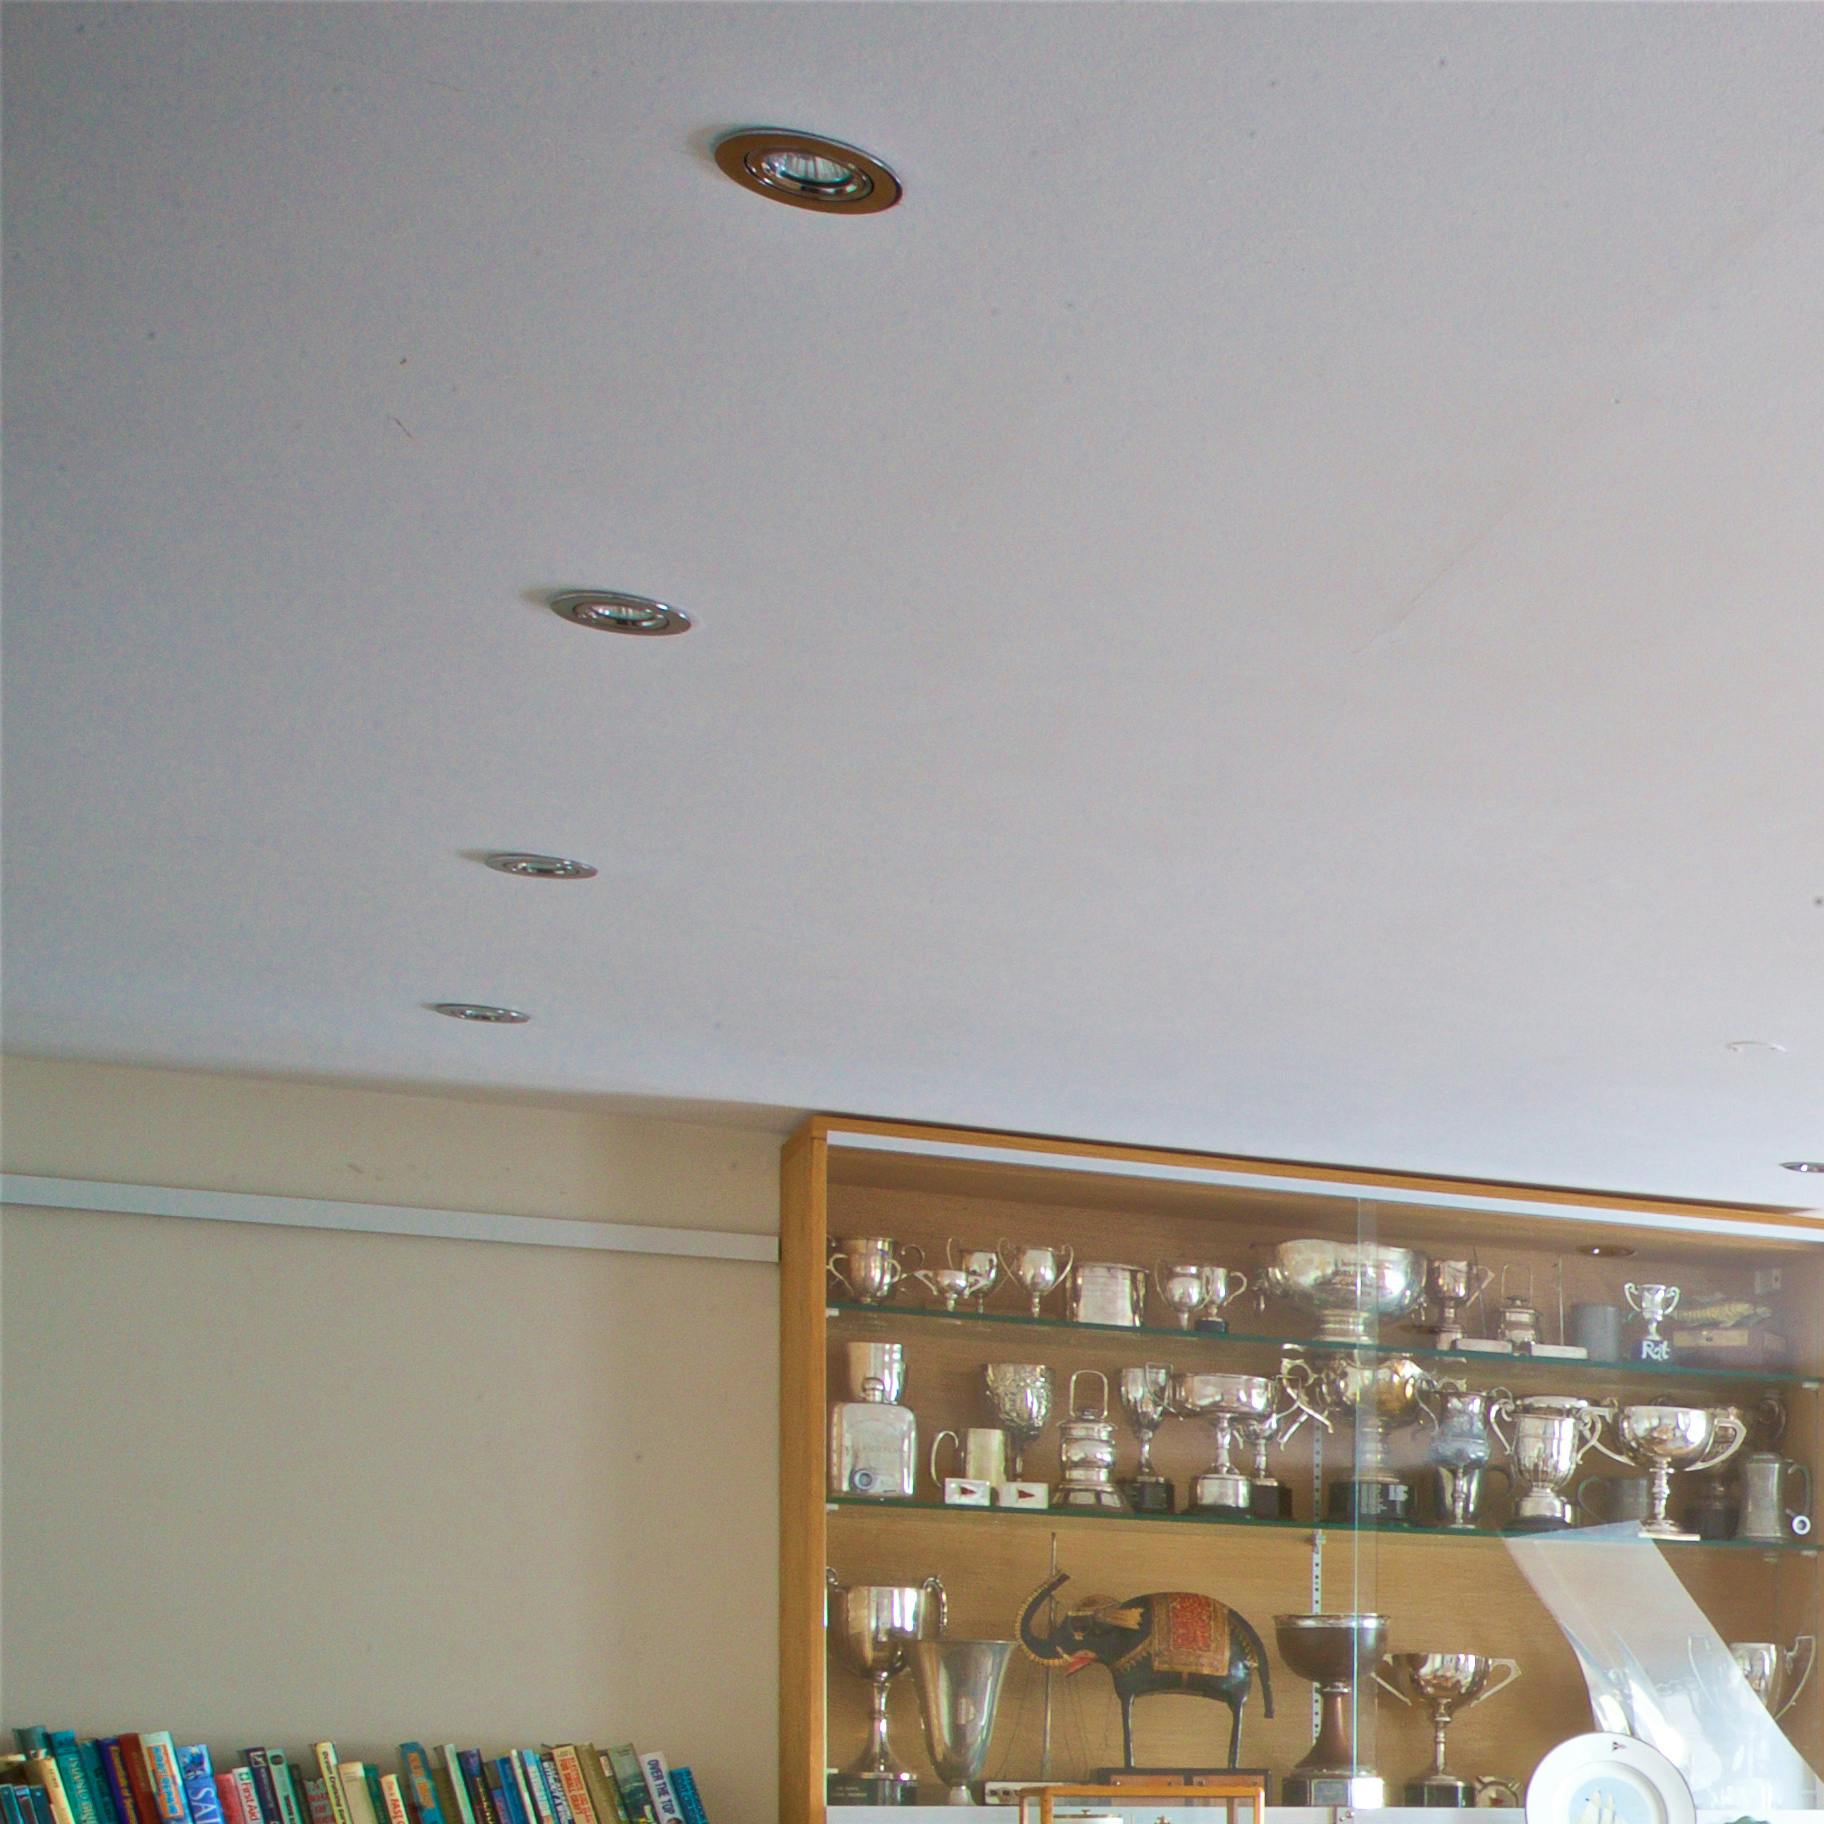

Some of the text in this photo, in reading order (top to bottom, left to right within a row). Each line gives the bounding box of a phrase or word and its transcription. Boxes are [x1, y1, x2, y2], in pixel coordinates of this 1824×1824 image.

[1641, 1340, 1671, 1361] Rat
[242, 1782, 255, 1803] First
[648, 1759, 674, 1815] OVER THE TOP
[248, 1804, 258, 1820] Aid
